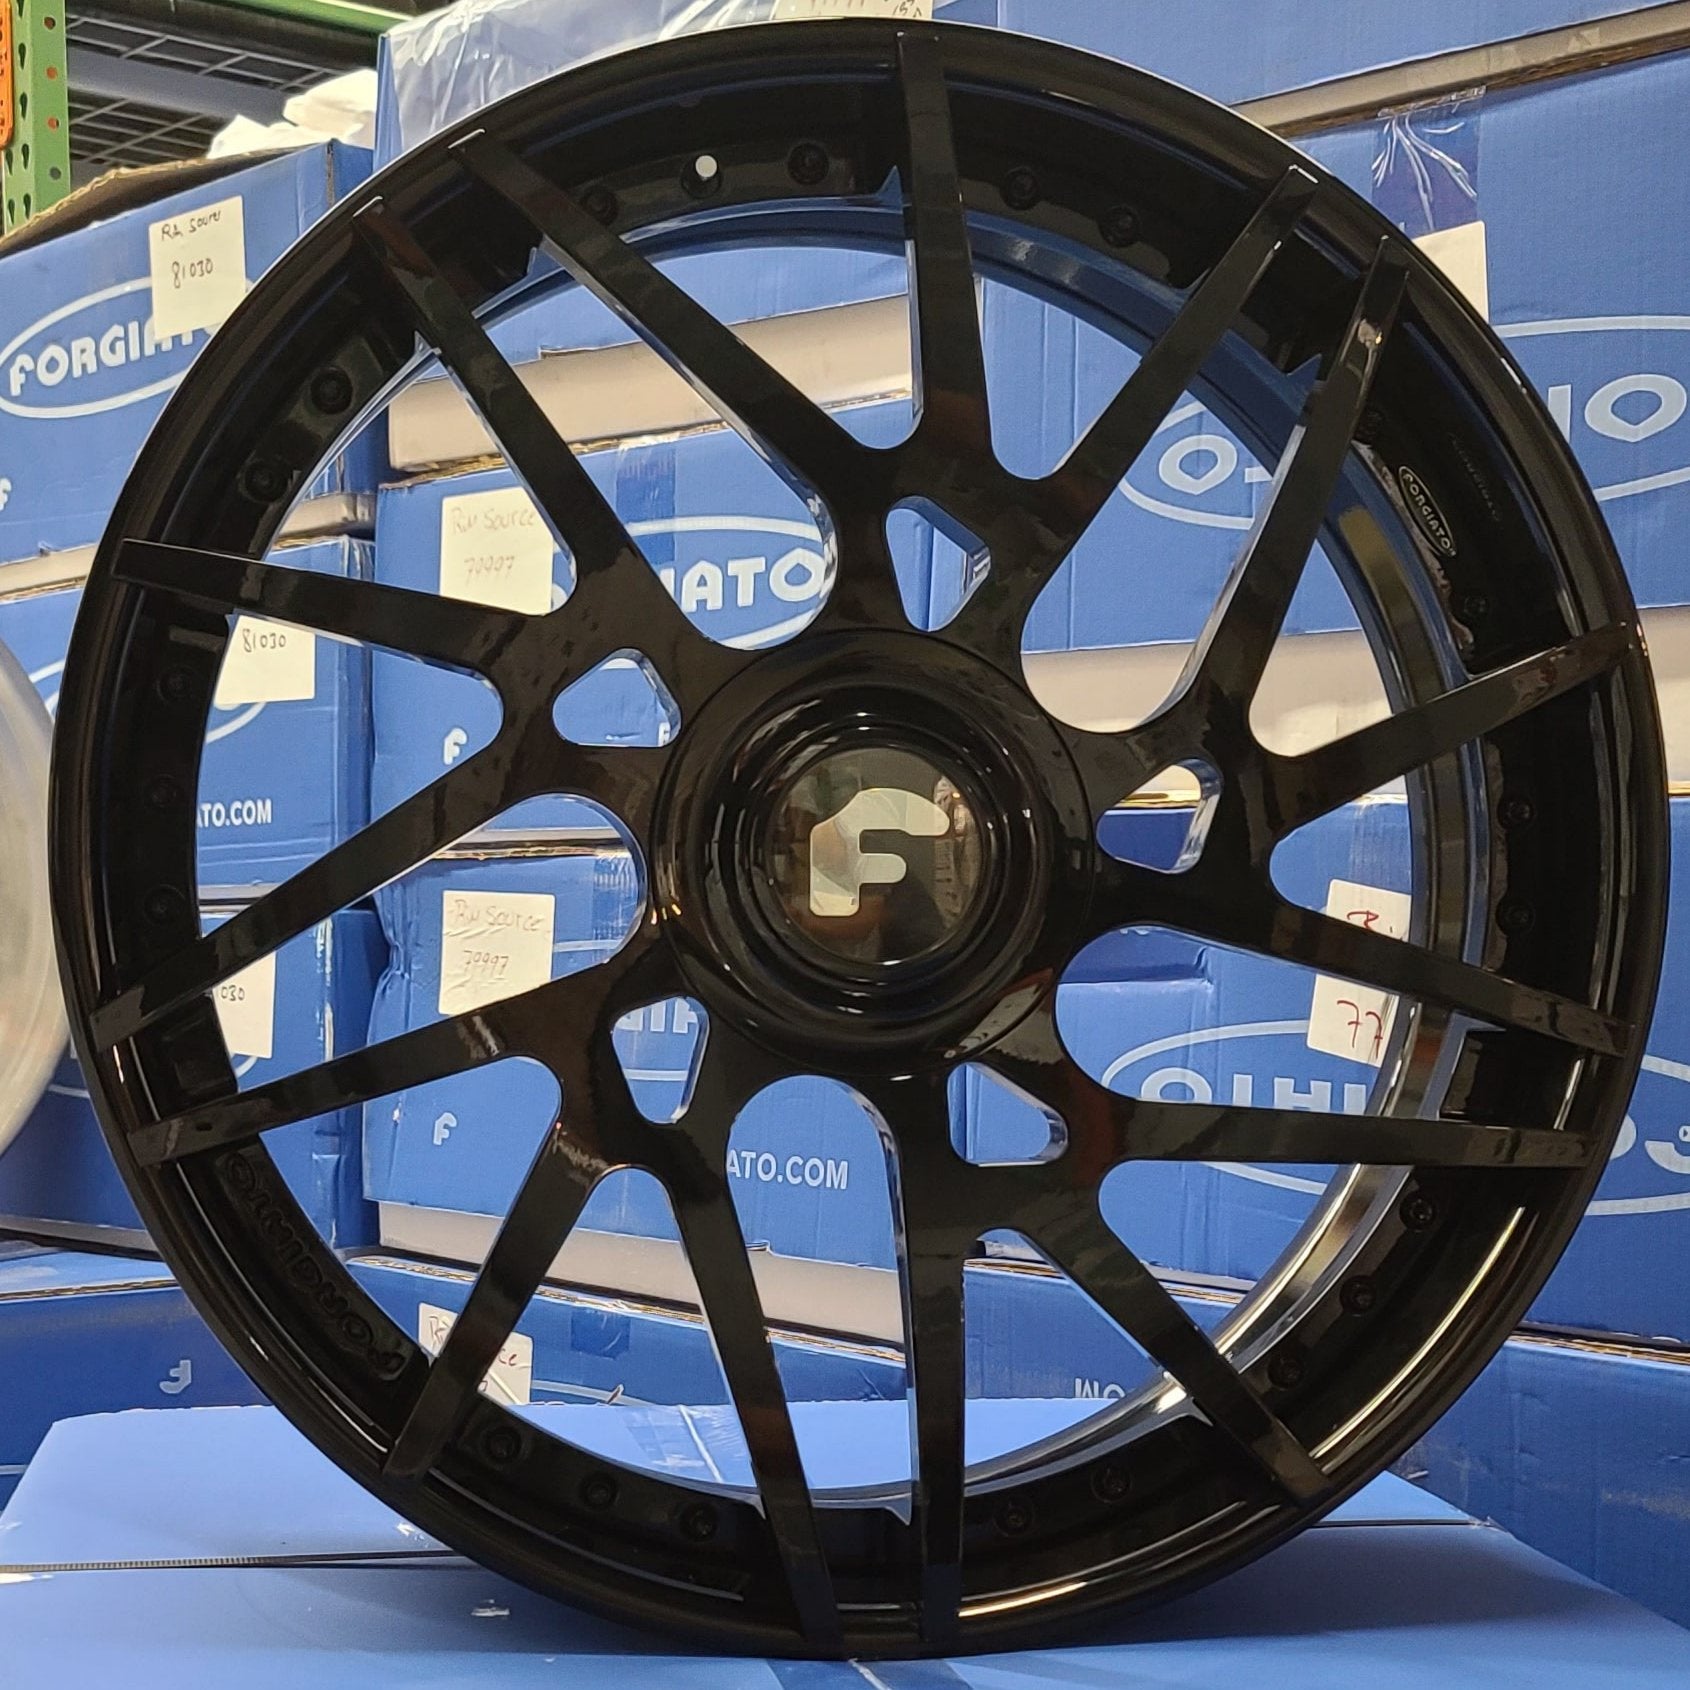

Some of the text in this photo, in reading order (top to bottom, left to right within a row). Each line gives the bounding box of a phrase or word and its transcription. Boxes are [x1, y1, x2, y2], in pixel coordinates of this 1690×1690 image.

[171, 259, 214, 289] 81030
[1402, 473, 1451, 549] FORGIATO
[241, 628, 287, 653] 81030
[443, 727, 468, 766] F
[433, 1111, 458, 1146] F
